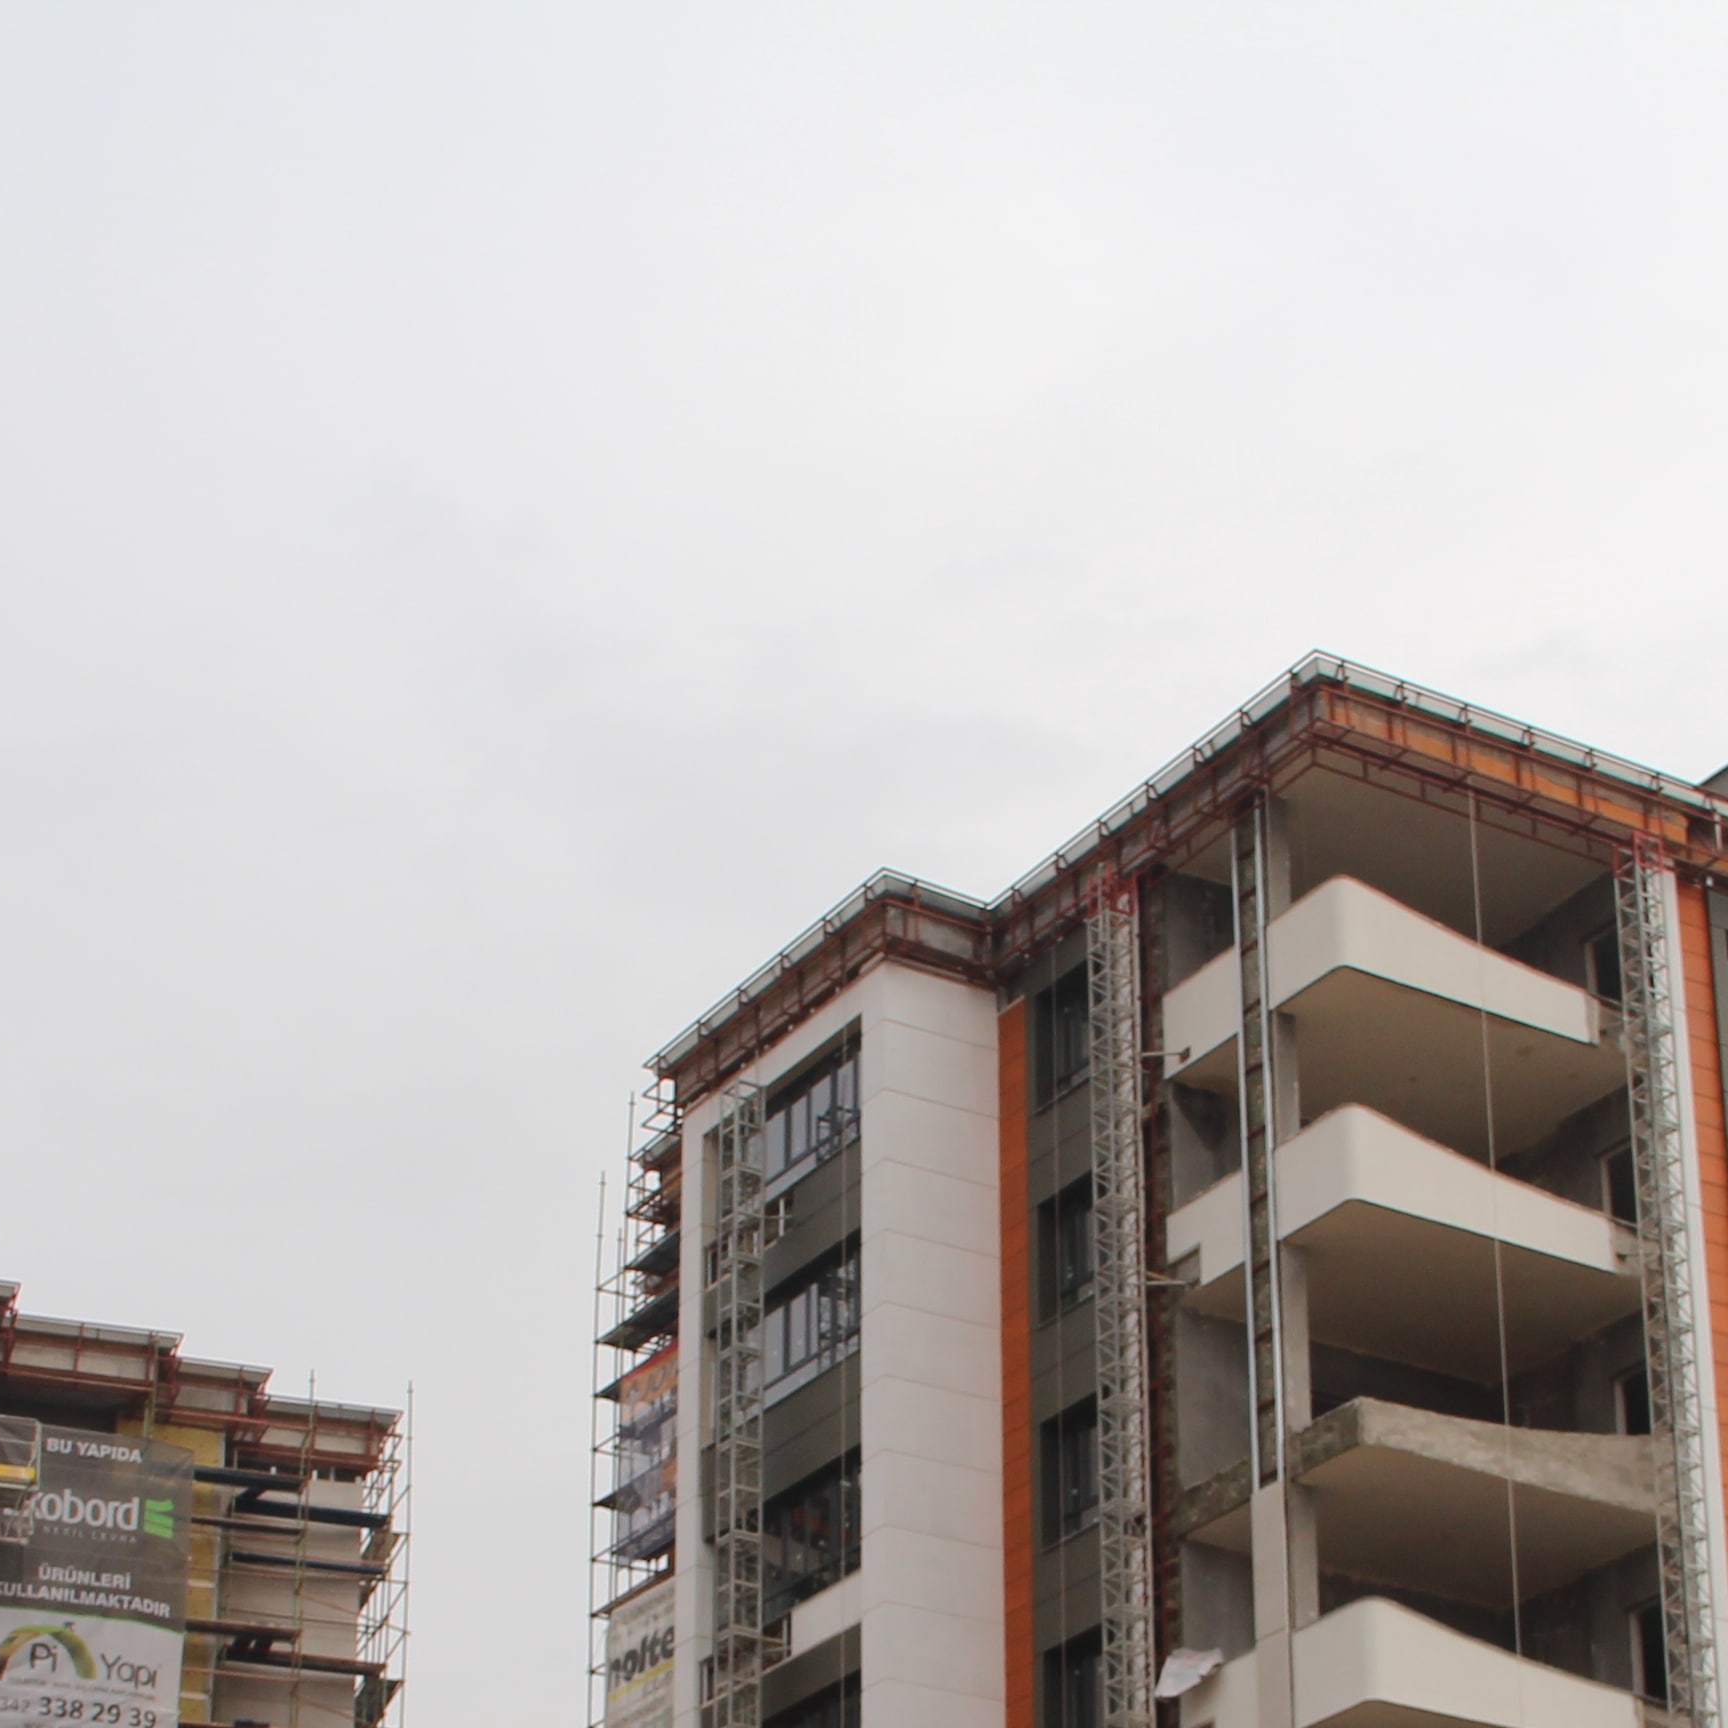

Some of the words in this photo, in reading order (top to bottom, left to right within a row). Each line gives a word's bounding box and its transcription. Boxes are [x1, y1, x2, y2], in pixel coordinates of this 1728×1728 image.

[46, 1437, 73, 1453] BU
[76, 1441, 143, 1464] YAPIDA
[38, 1562, 131, 1590] ÜRÜNLERİ
[39, 1696, 83, 1719] 338
[91, 1702, 121, 1724] 29
